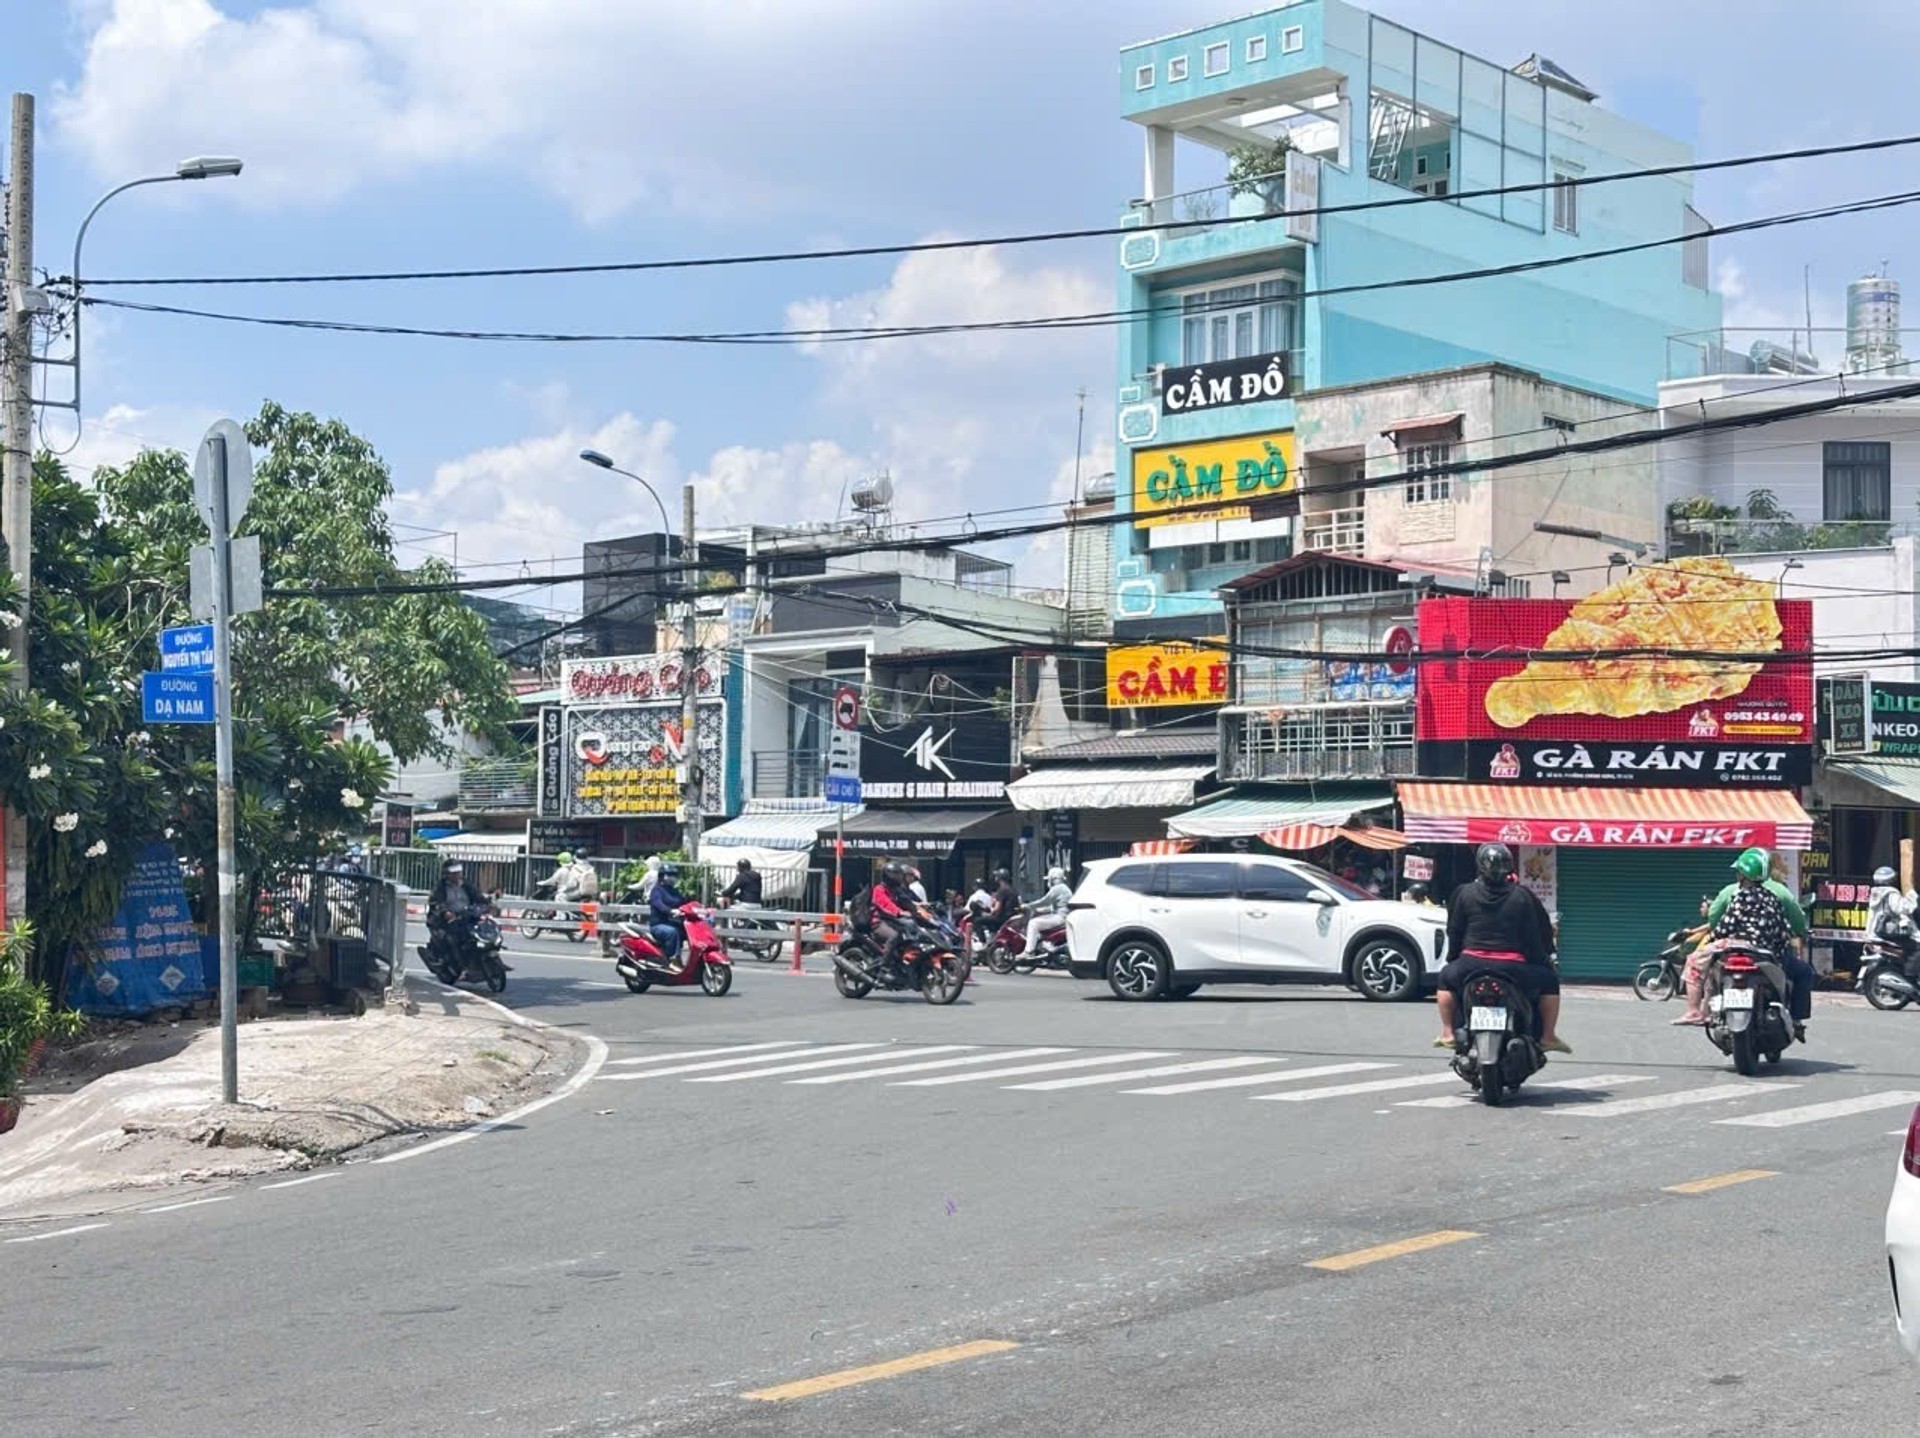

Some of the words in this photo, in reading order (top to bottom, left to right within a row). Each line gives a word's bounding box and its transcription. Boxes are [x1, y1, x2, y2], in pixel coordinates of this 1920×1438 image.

[1166, 369, 1232, 409] CẦM
[1240, 356, 1284, 400] ĐỒ
[1146, 454, 1222, 502] CẦM
[1236, 441, 1287, 492] ĐỒ
[174, 632, 203, 646] ĐƯỜNG
[161, 679, 198, 692] ĐƯỜNG
[1117, 656, 1198, 698] CẦM
[155, 699, 173, 718] DẠ
[176, 700, 204, 714] NAM
[1835, 704, 1862, 719] KEO
[546, 713, 557, 744] Cáo
[1533, 744, 1594, 768] GÀ
[1606, 744, 1704, 770] RÁN
[1713, 751, 1786, 770] FKT
[545, 746, 559, 797] Quảng
[1495, 767, 1517, 776] FKT
[906, 783, 914, 798] &
[916, 782, 945, 798] HAIR
[947, 781, 1004, 798] BRAIDING
[1551, 822, 1594, 843] GÀ
[1603, 824, 1677, 843] RÁN
[1681, 829, 1752, 844] FKT
[1046, 840, 1071, 872] CẦM
